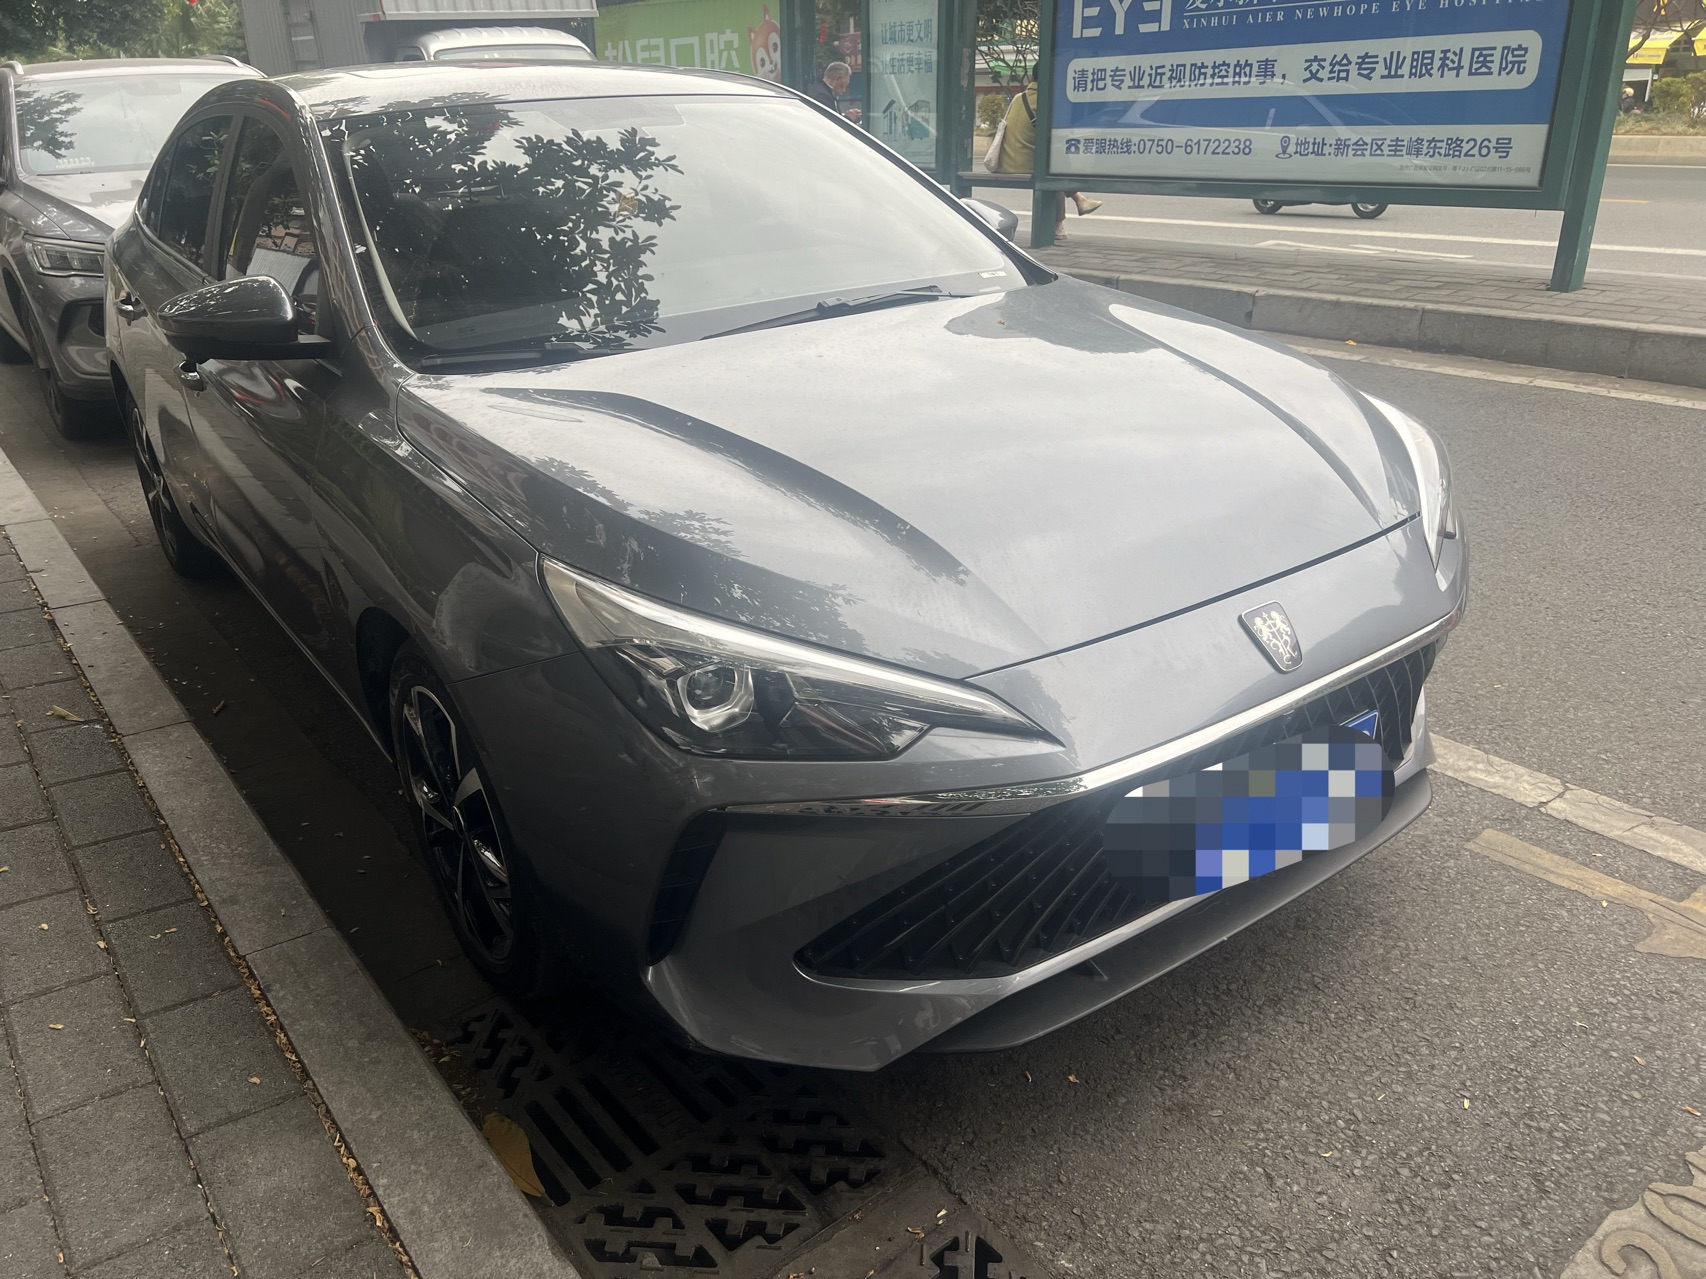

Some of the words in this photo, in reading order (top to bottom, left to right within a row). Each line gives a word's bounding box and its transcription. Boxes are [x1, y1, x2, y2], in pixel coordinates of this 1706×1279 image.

[1182, 15, 1238, 29] XINHUI
[1246, 11, 1285, 24] AIER
[1294, 2, 1380, 20] NEWHOPE
[1391, 0, 1427, 12] EYE
[881, 19, 933, 45] 让城市更文明
[881, 50, 933, 75] 让生活更幸福
